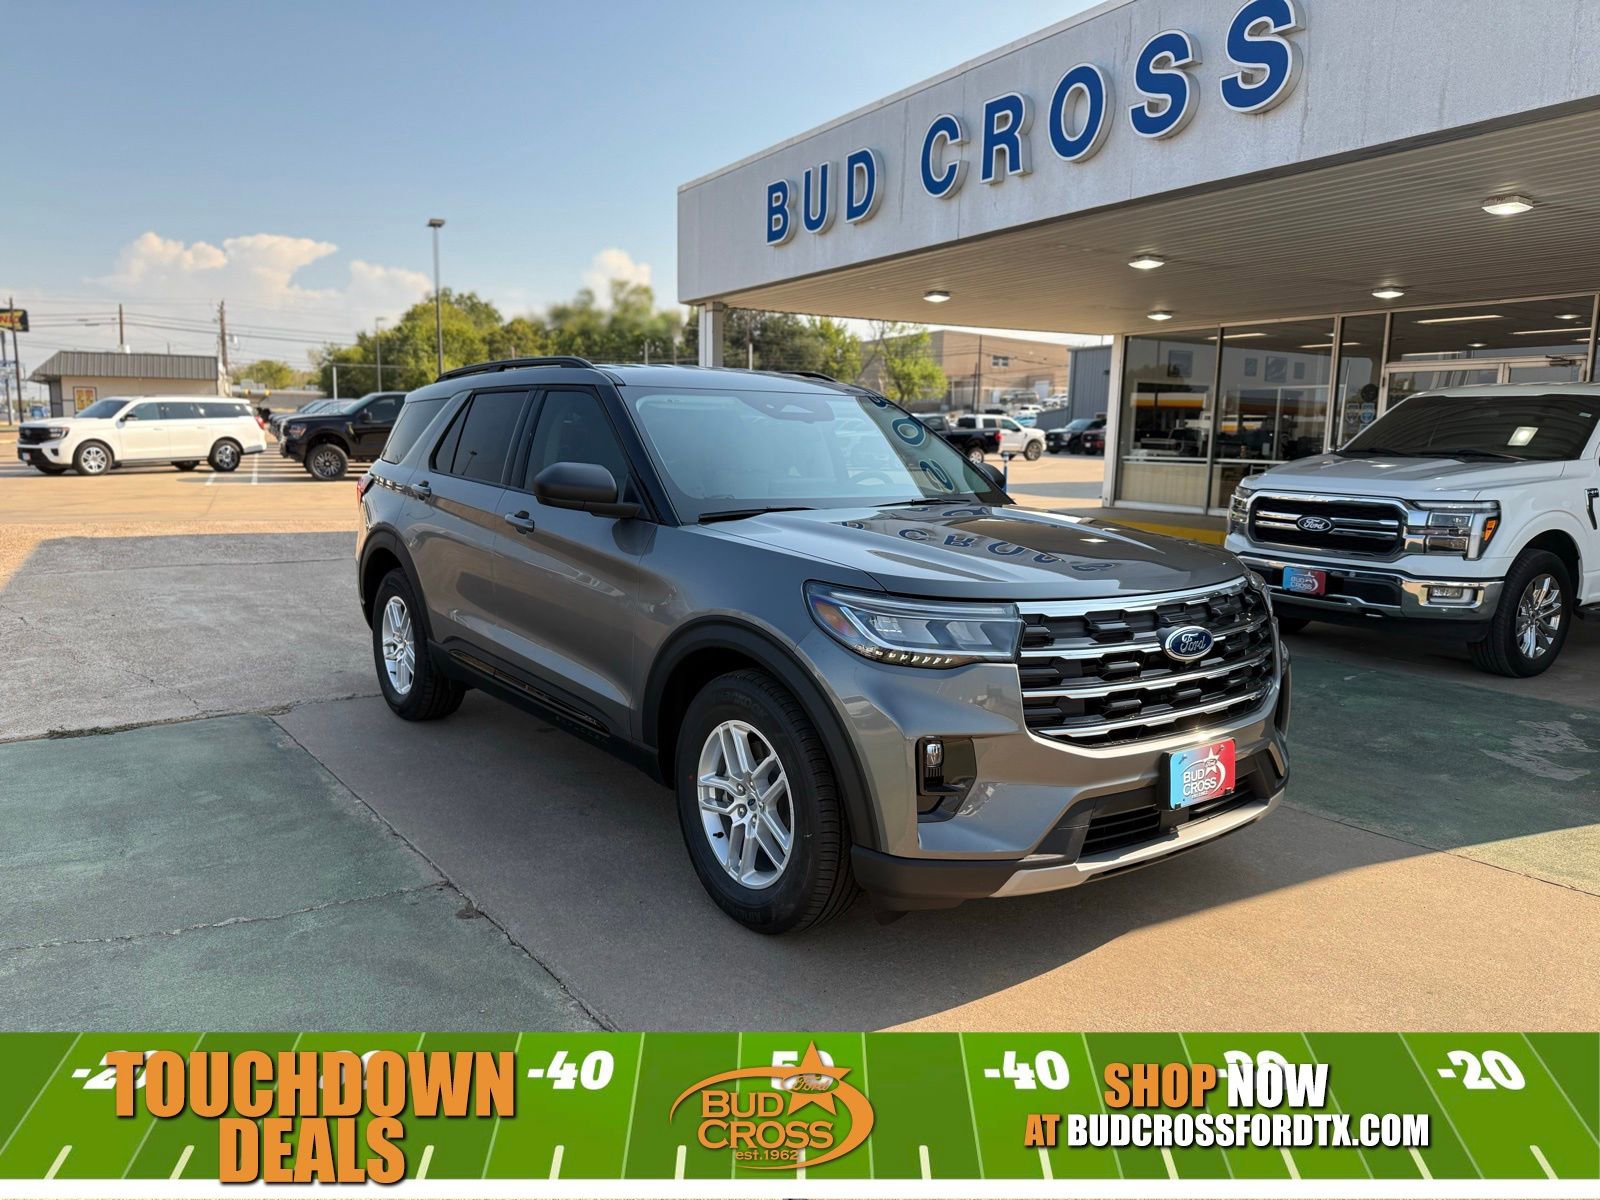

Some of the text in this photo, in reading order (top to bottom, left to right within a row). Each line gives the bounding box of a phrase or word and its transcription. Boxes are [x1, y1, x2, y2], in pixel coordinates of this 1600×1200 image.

[766, 0, 1305, 246] BUD CROSS
[1303, 519, 1326, 530] Ford
[1180, 632, 1207, 653] Ford
[1183, 768, 1204, 784] BUD
[1182, 777, 1217, 796] CROSS
